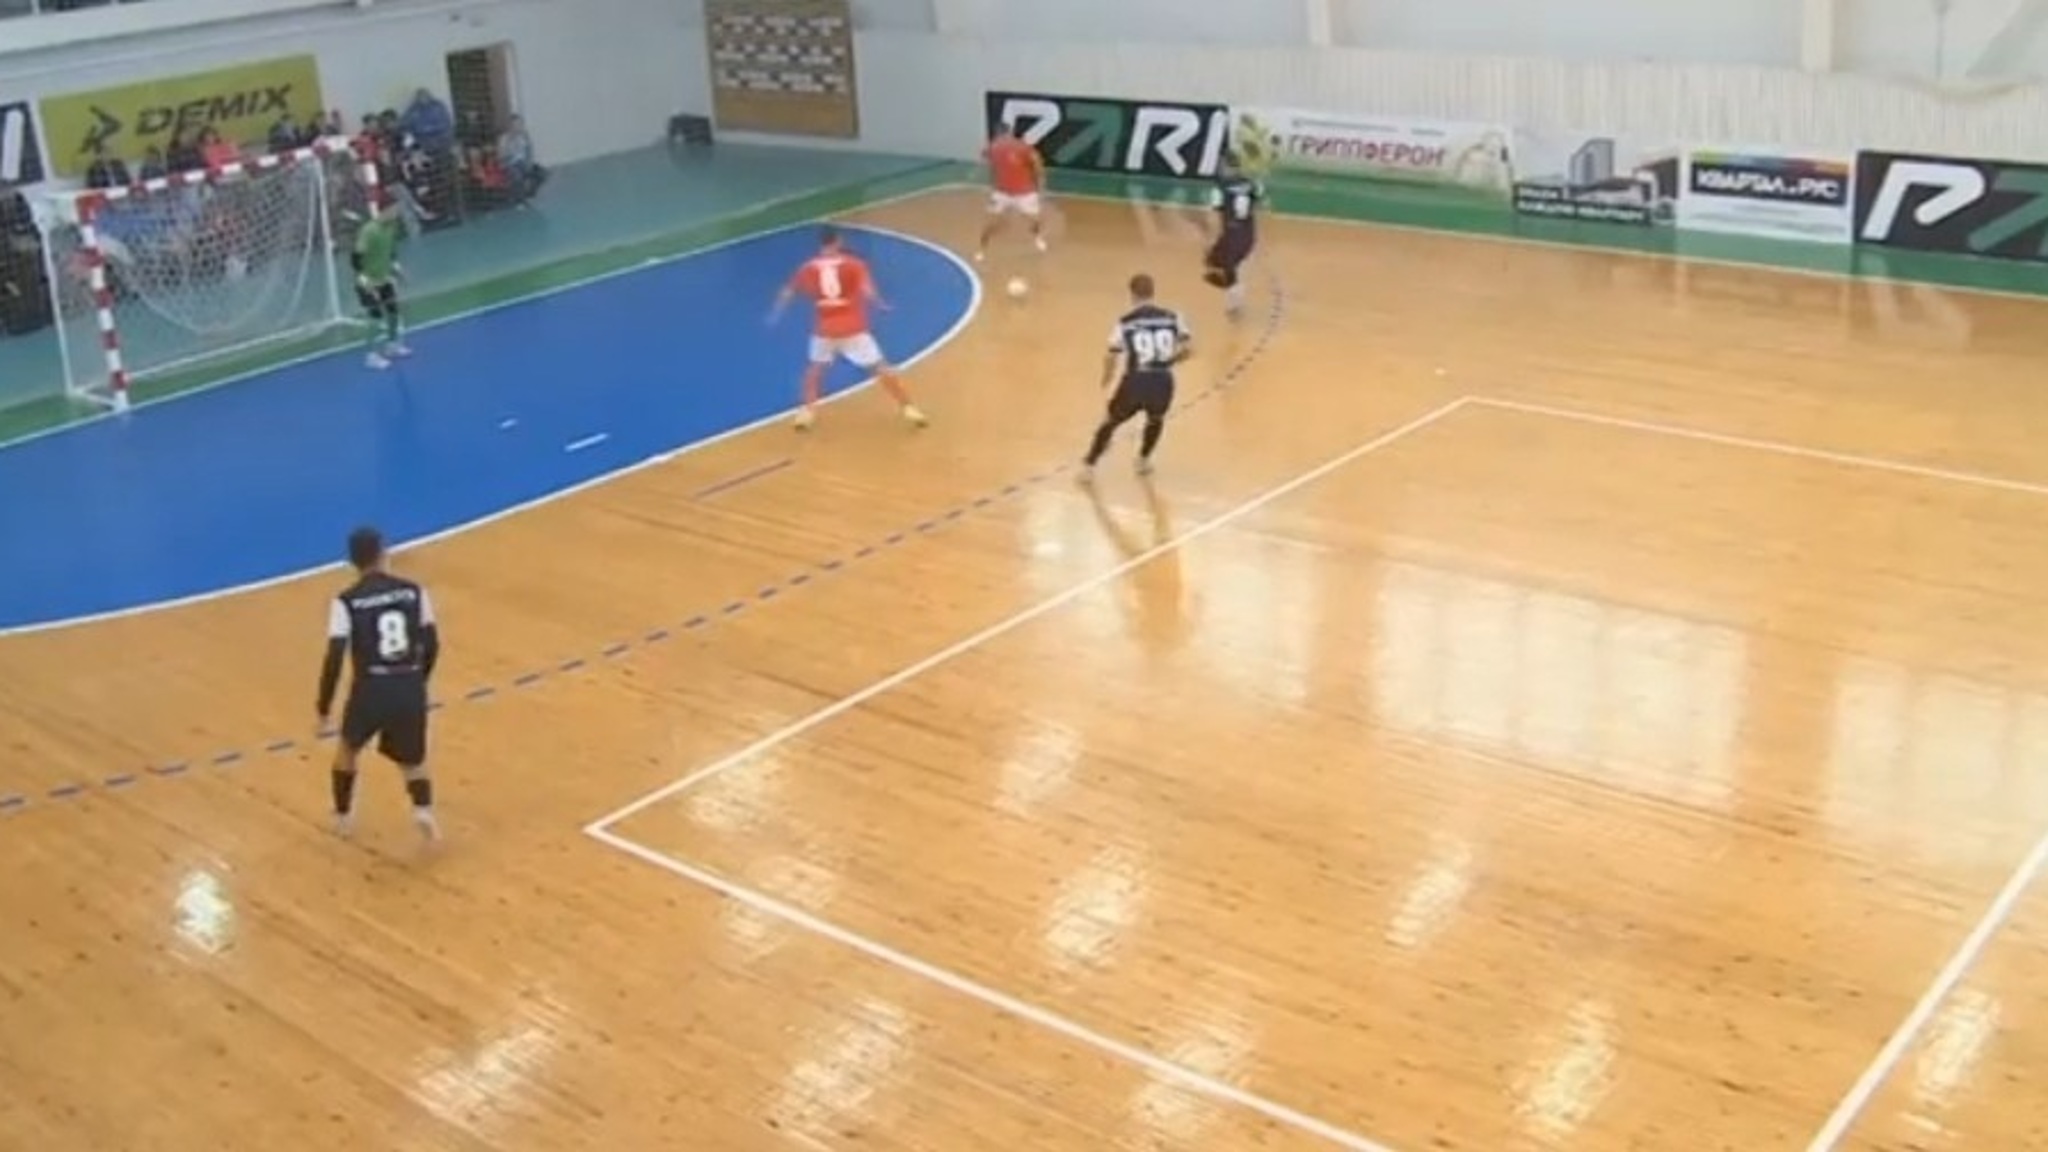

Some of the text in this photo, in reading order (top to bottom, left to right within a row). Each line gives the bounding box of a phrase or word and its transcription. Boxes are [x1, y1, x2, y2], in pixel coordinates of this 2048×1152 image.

[136, 83, 292, 135] DEMIX
[1133, 328, 1174, 364] 99
[378, 609, 408, 660] 8
